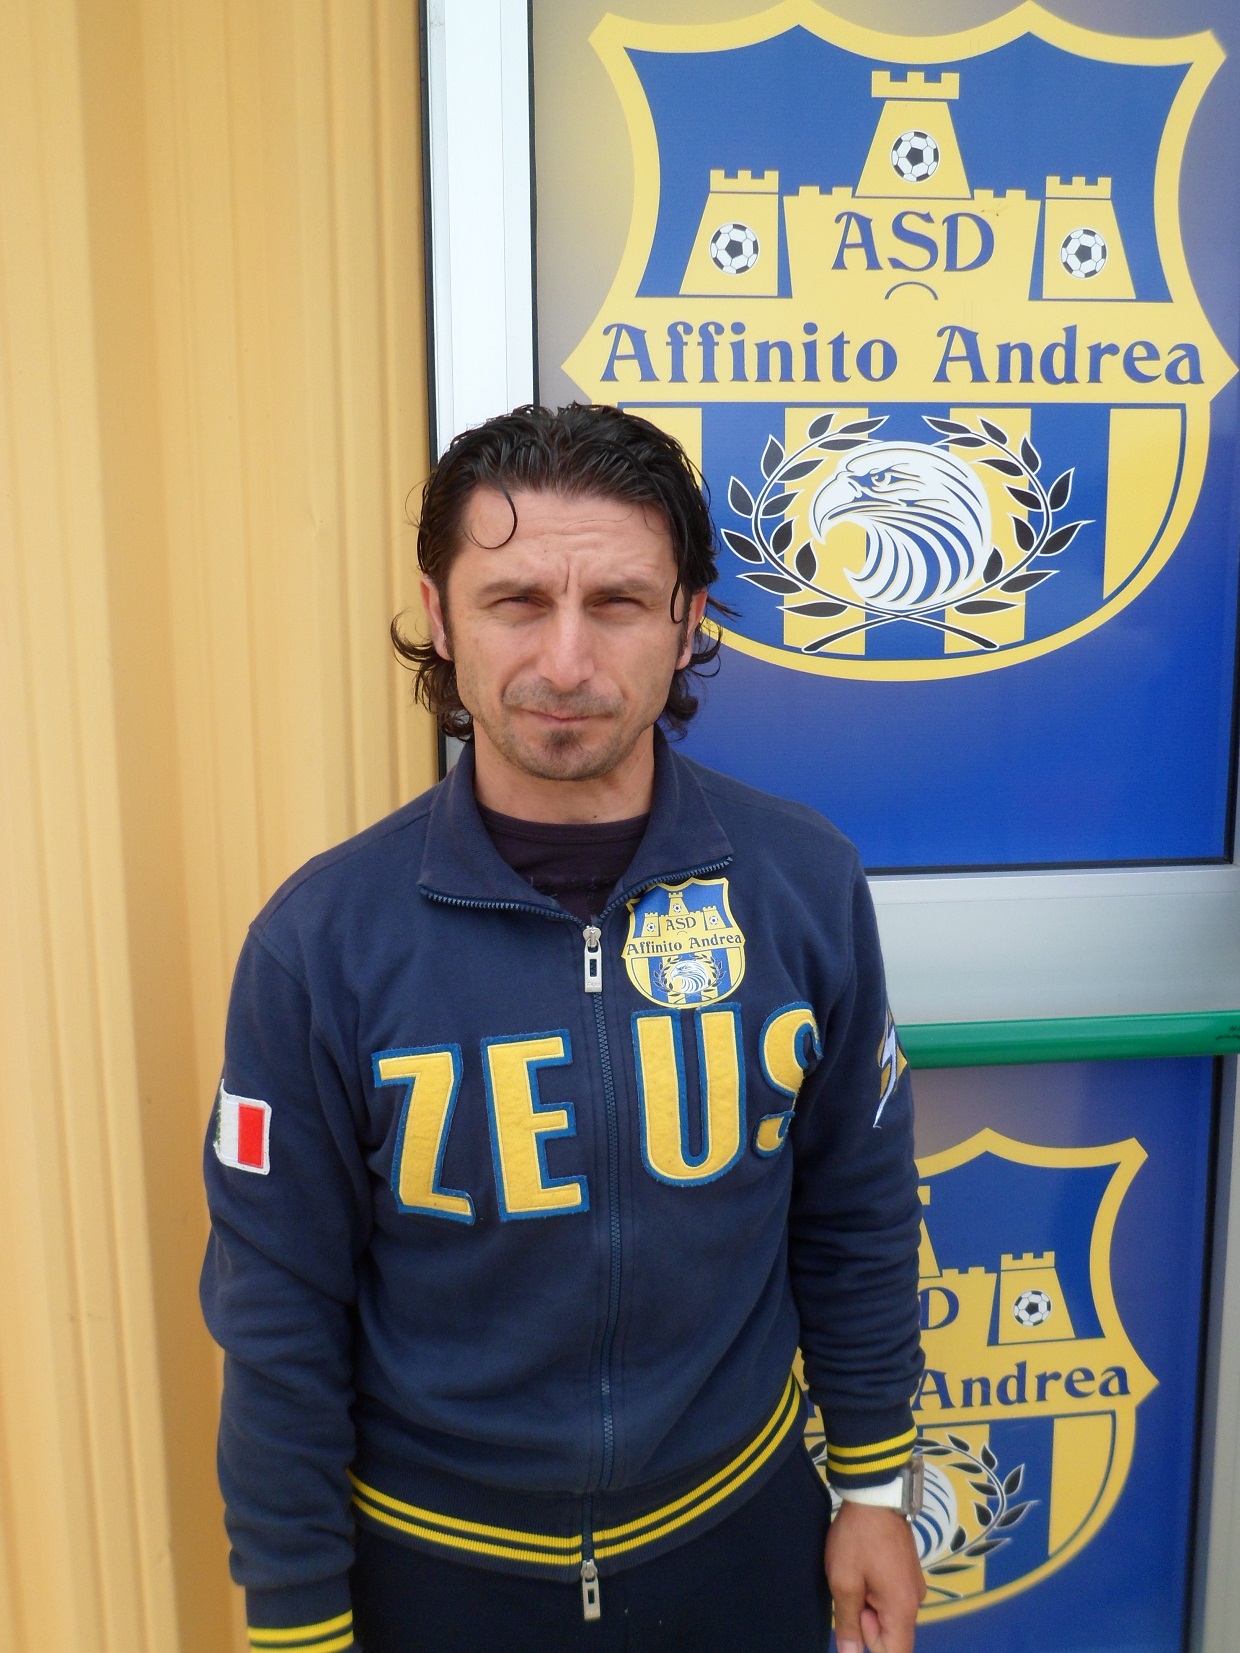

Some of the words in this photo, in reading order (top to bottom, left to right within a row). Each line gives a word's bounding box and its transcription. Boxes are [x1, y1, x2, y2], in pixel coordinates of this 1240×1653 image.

[831, 210, 996, 272] ASD
[600, 322, 898, 383] Affinito
[932, 323, 1206, 385] Andrea
[626, 941, 682, 956] Affinito
[688, 934, 742, 949] Andrea
[666, 916, 697, 931] ASD
[372, 1002, 823, 1225] ZEUS
[912, 1360, 1131, 1411] Andrea
